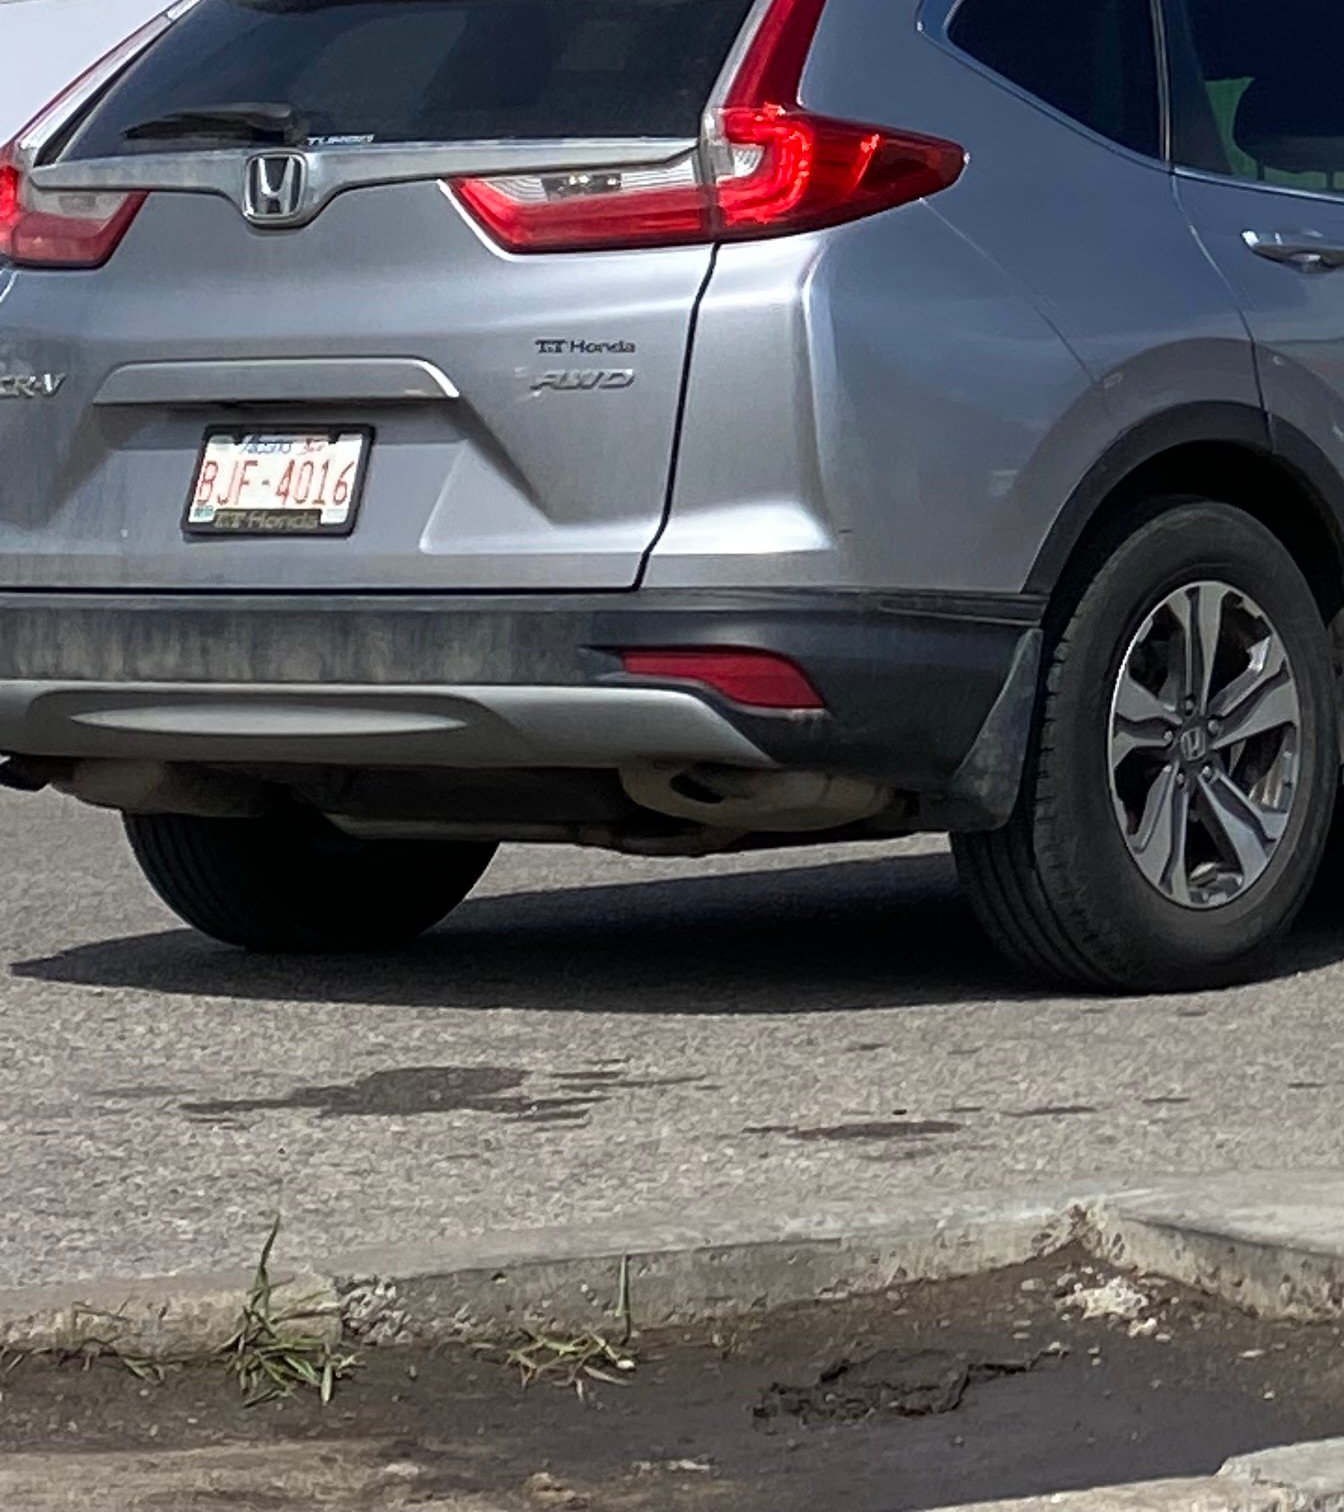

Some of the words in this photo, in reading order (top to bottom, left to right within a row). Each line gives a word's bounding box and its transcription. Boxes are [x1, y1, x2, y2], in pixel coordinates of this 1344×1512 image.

[569, 339, 636, 354] Honda
[530, 369, 635, 391] AWD
[196, 458, 356, 506] BJF-4016
